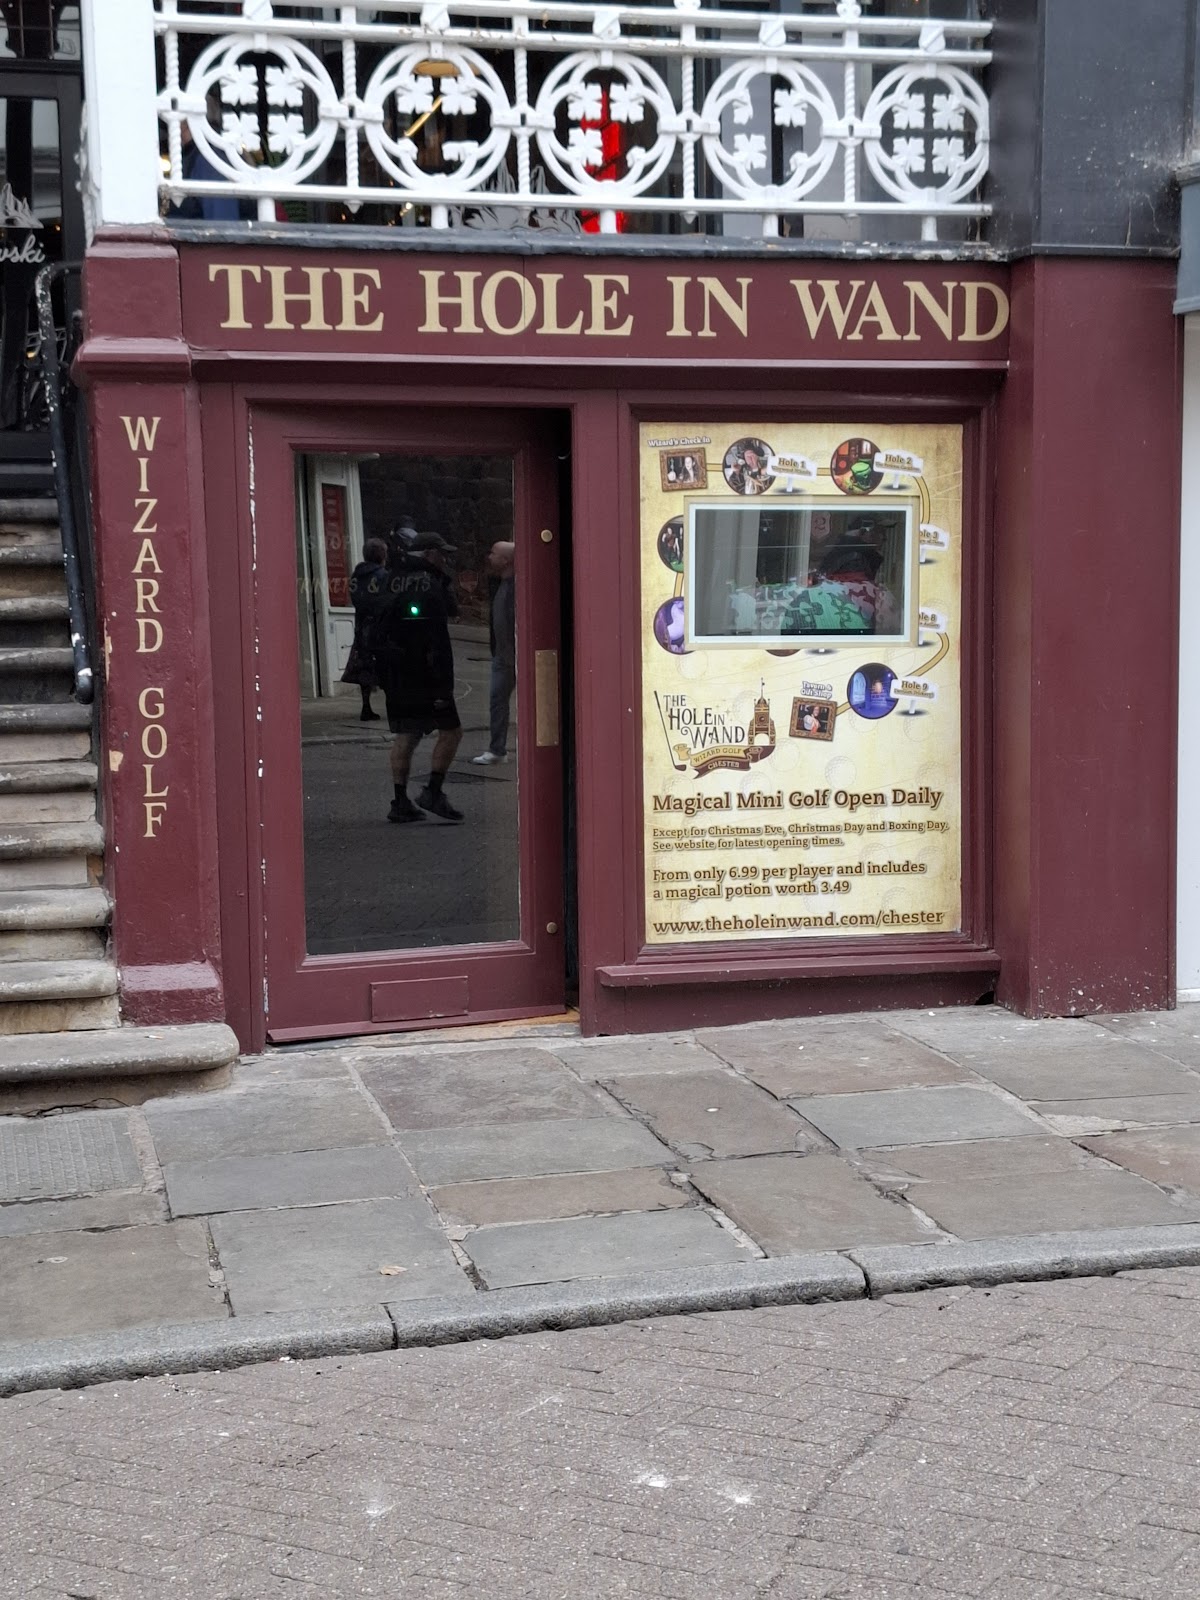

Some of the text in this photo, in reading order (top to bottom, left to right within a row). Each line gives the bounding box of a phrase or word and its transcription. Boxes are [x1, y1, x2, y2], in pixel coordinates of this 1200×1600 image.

[0, 234, 46, 263] ski
[208, 264, 1010, 342] THE HOLE IN WAND
[648, 438, 679, 447] Wizard's
[680, 436, 701, 445] Check
[778, 457, 806, 469] Hole 1
[885, 454, 912, 465] Hole 2
[920, 529, 939, 539] ole 3
[367, 577, 380, 593] &
[391, 576, 431, 593] GIFTS
[930, 613, 936, 622] 8
[119, 416, 169, 838] WIZARD GOLF
[901, 680, 928, 691] Hole 9
[663, 695, 686, 712] THE
[668, 708, 725, 730] HOLE IN
[681, 726, 745, 748] WAND
[693, 749, 721, 763] WIZARD
[708, 760, 740, 770] CHESTER
[652, 787, 942, 815] Magical Mini Golf Open Daily
[652, 820, 949, 838] Except for Christmas Eve, Christmas Day and Boxing Day.
[652, 836, 844, 850] See website for latest opening times.
[653, 860, 926, 881] From only 6.99 per player and includes
[653, 880, 850, 901] a magical potion worth 3.49
[653, 910, 944, 933] www.theholeinwand.com/chester
